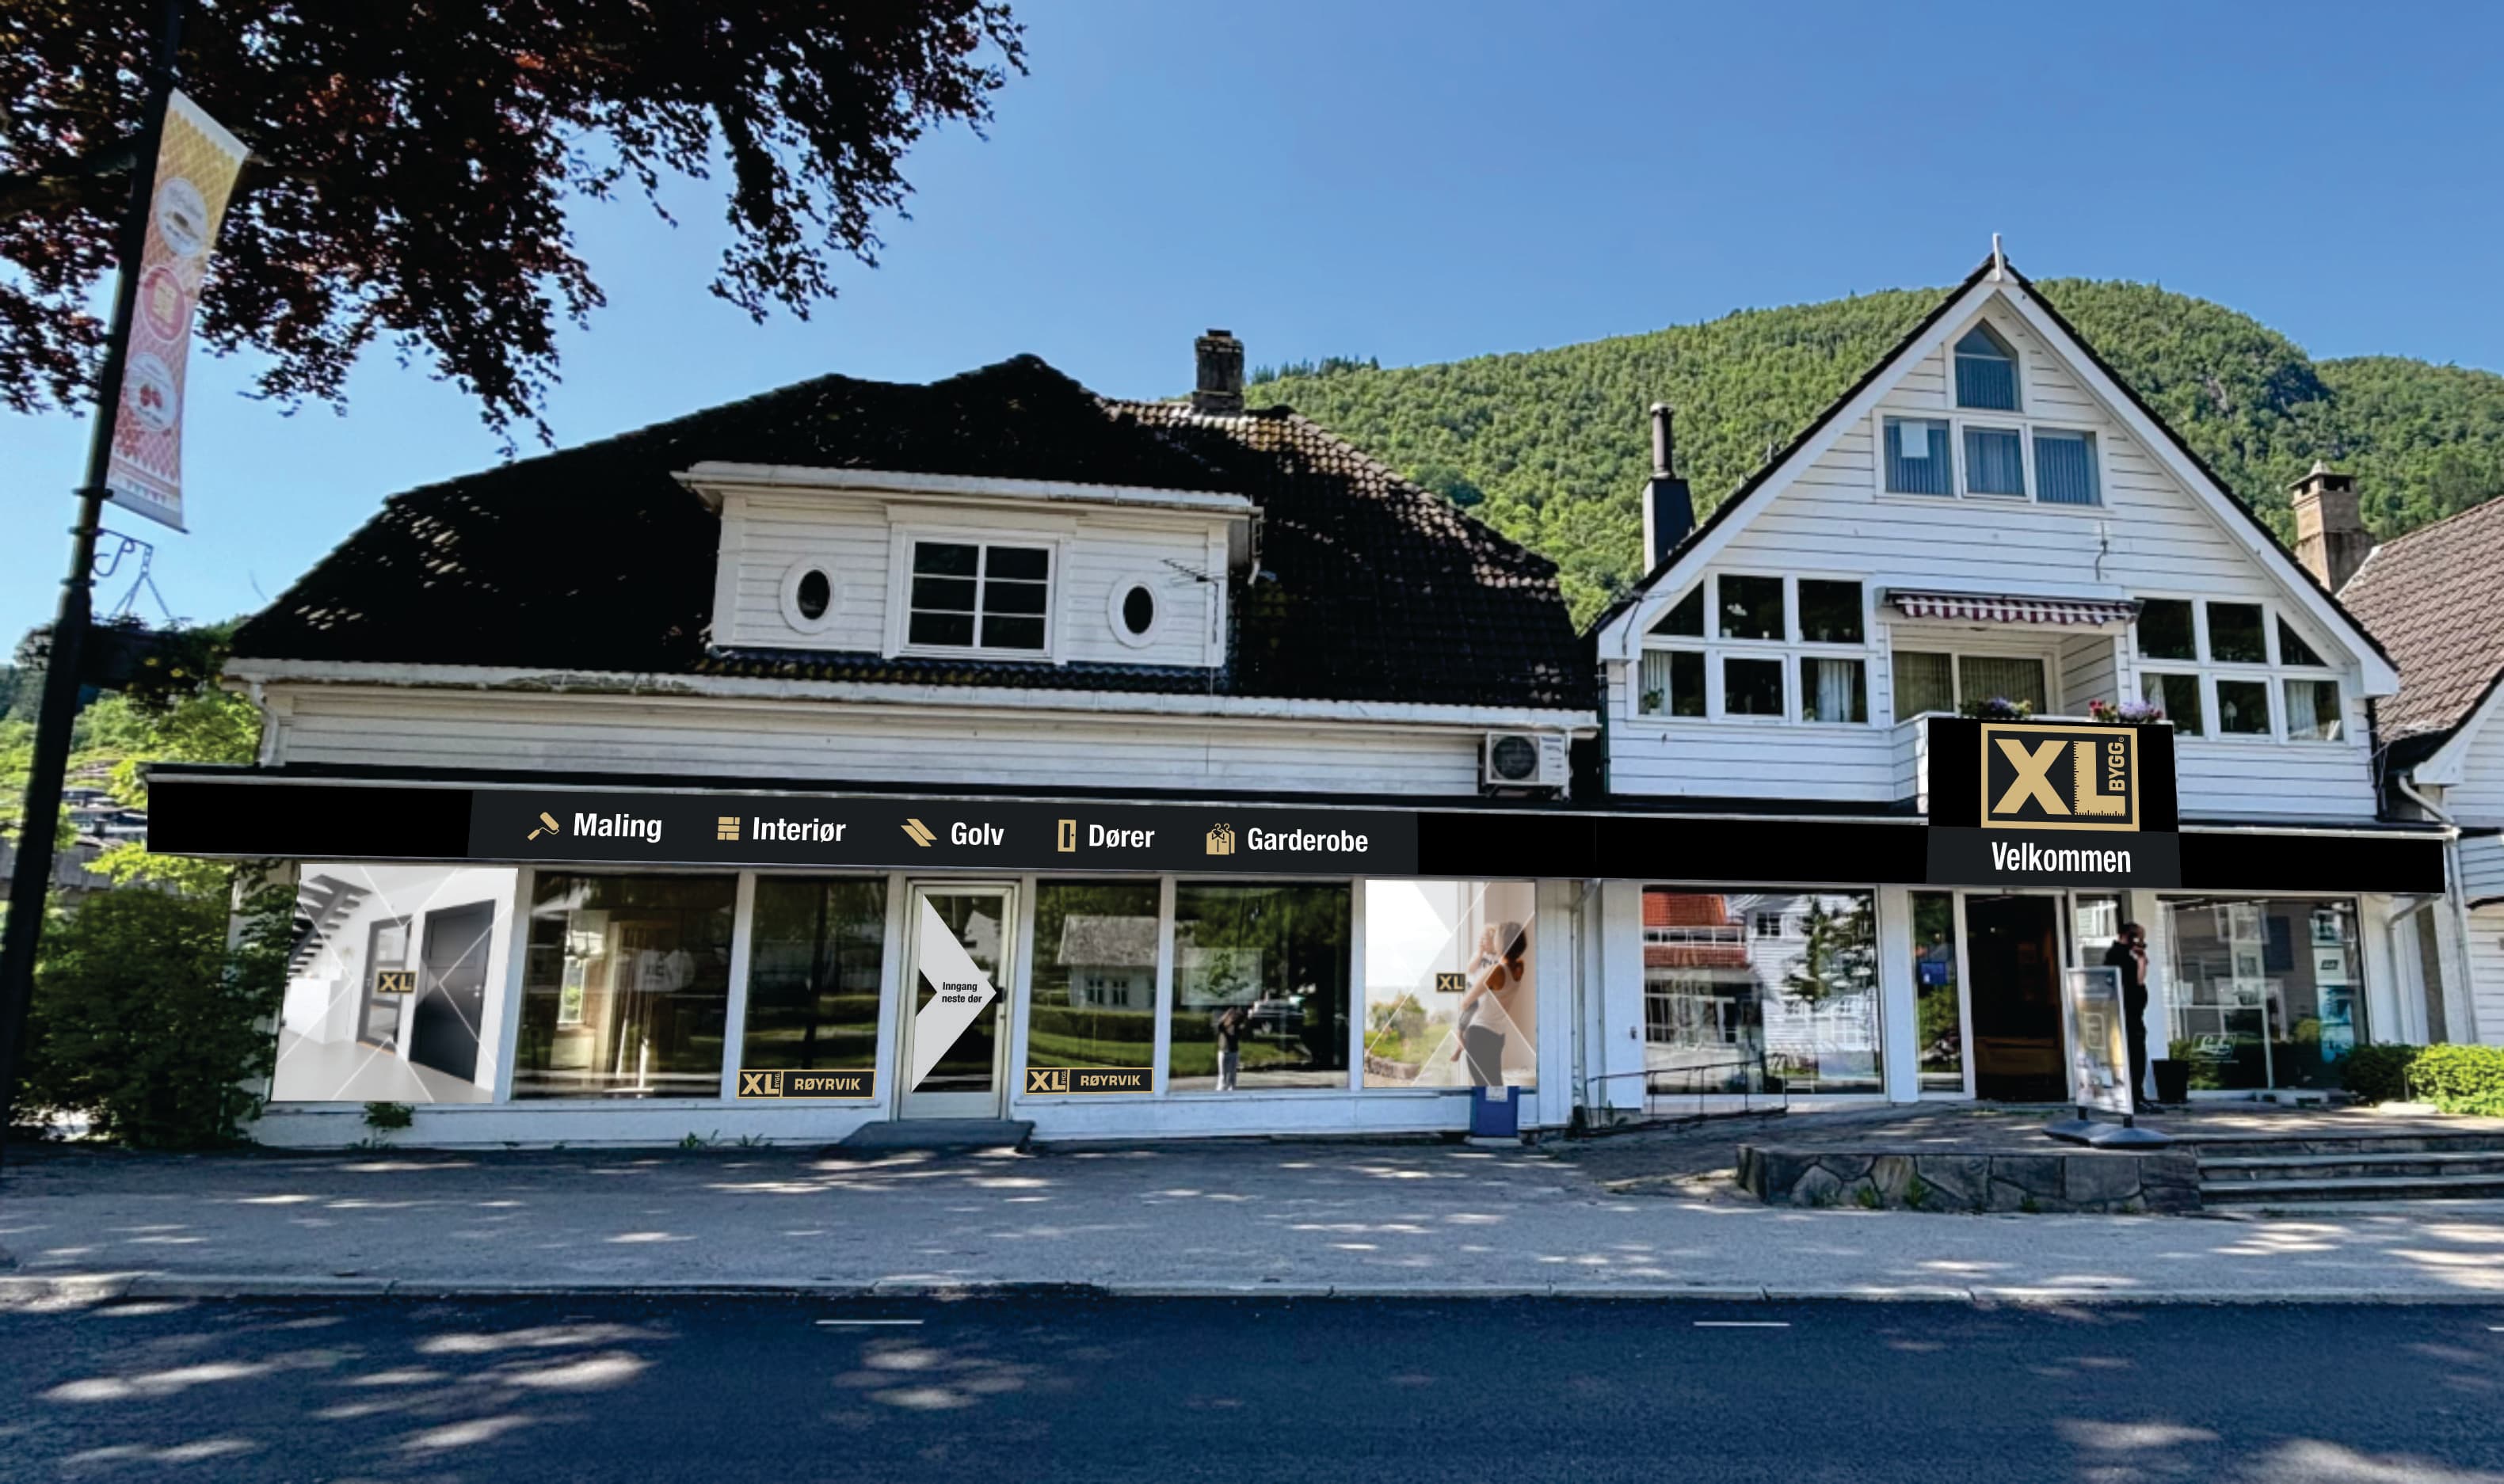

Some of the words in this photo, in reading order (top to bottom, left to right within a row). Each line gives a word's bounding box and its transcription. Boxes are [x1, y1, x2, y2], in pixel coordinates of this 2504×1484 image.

[1991, 737, 2126, 816] XL
[574, 812, 662, 843] Maling
[753, 816, 847, 843] Interiør
[951, 821, 1005, 847] Golv
[1088, 824, 1156, 849] Dører
[1248, 827, 1370, 854] Garderobe
[1991, 841, 2132, 873] Velkommen
[379, 974, 413, 991] XL
[942, 981, 978, 992] Inngang
[1438, 975, 1464, 990] XL
[941, 995, 966, 1003] neste
[967, 995, 983, 1003] dør
[741, 1073, 779, 1095] XL
[794, 1078, 862, 1090] RØYRVIK
[1027, 1071, 1066, 1091] XL
[1080, 1075, 1141, 1086] RØYRVIK
